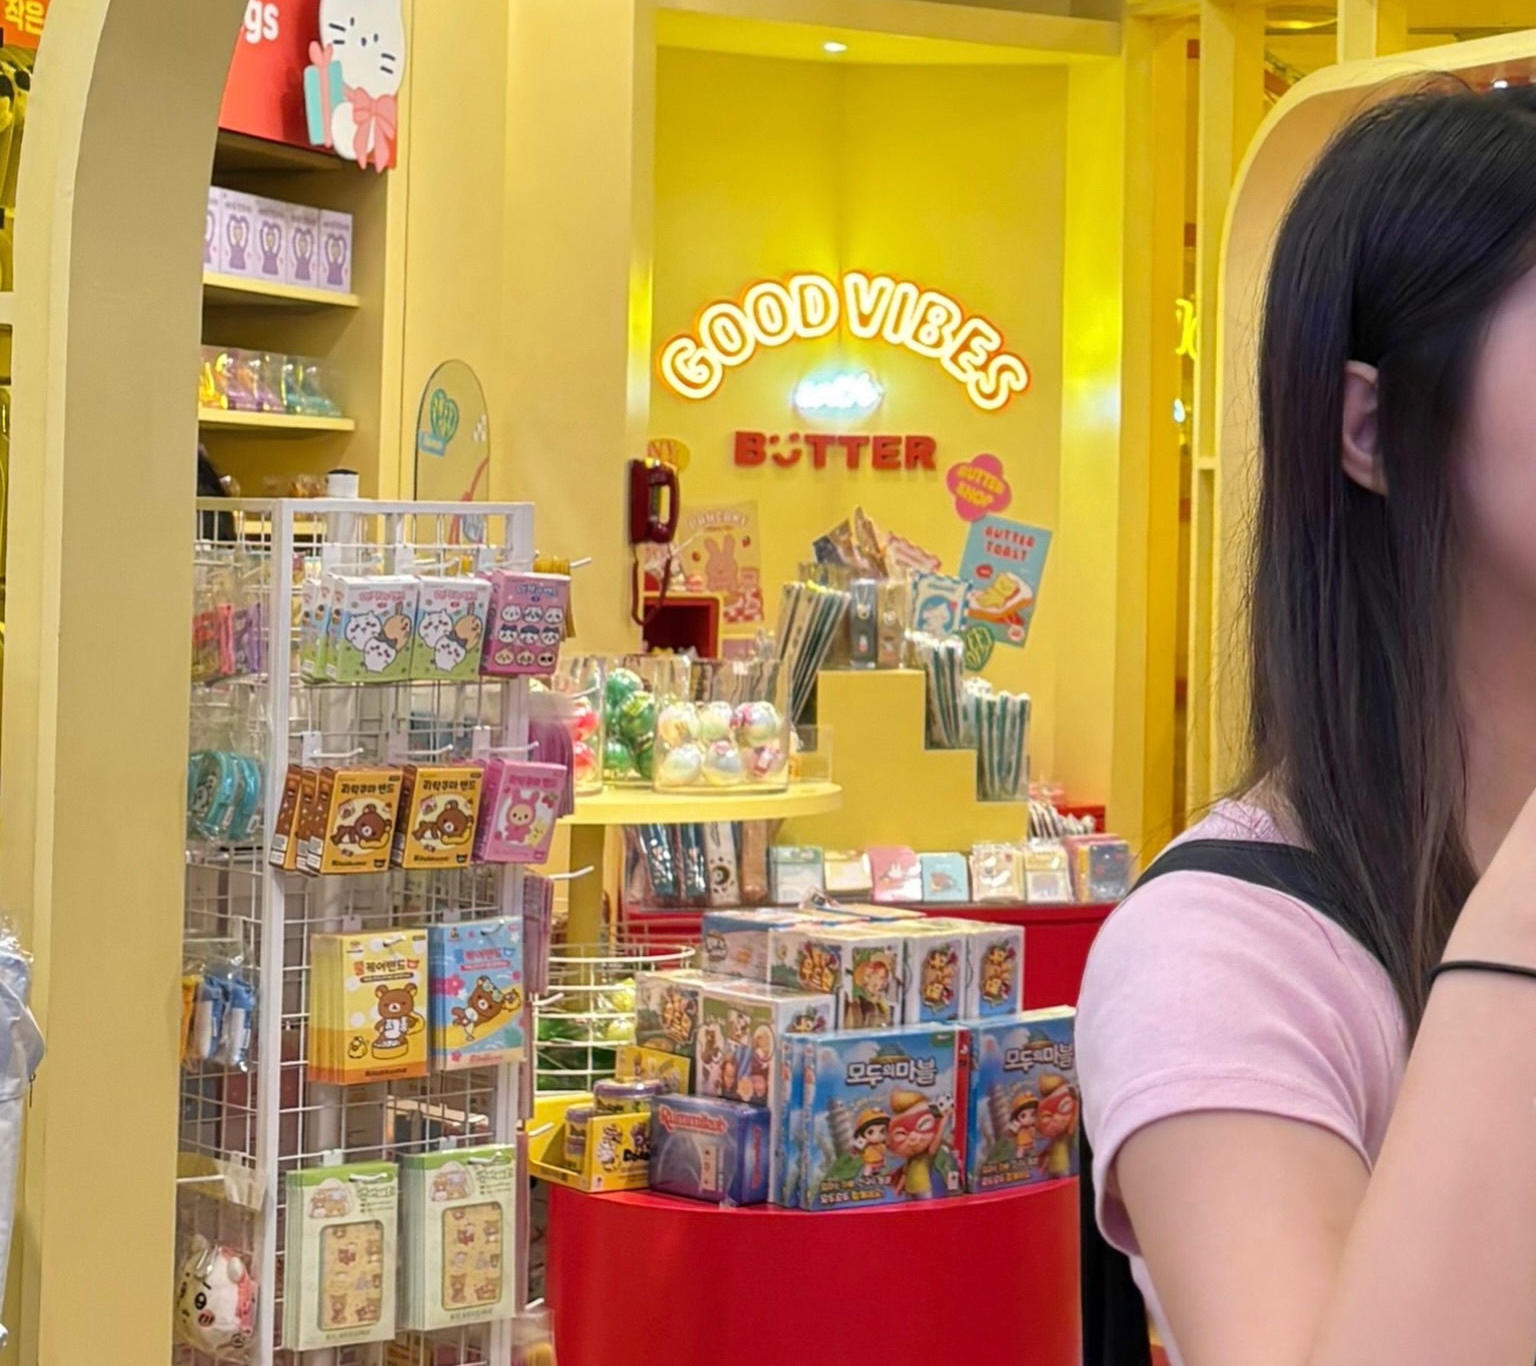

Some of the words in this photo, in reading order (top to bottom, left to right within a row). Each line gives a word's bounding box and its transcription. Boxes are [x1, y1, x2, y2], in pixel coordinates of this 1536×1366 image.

[661, 273, 840, 400] GOOD
[843, 272, 1029, 411] VIBES
[734, 430, 936, 471] BUTTER
[845, 1056, 938, 1089] 모두의마블
